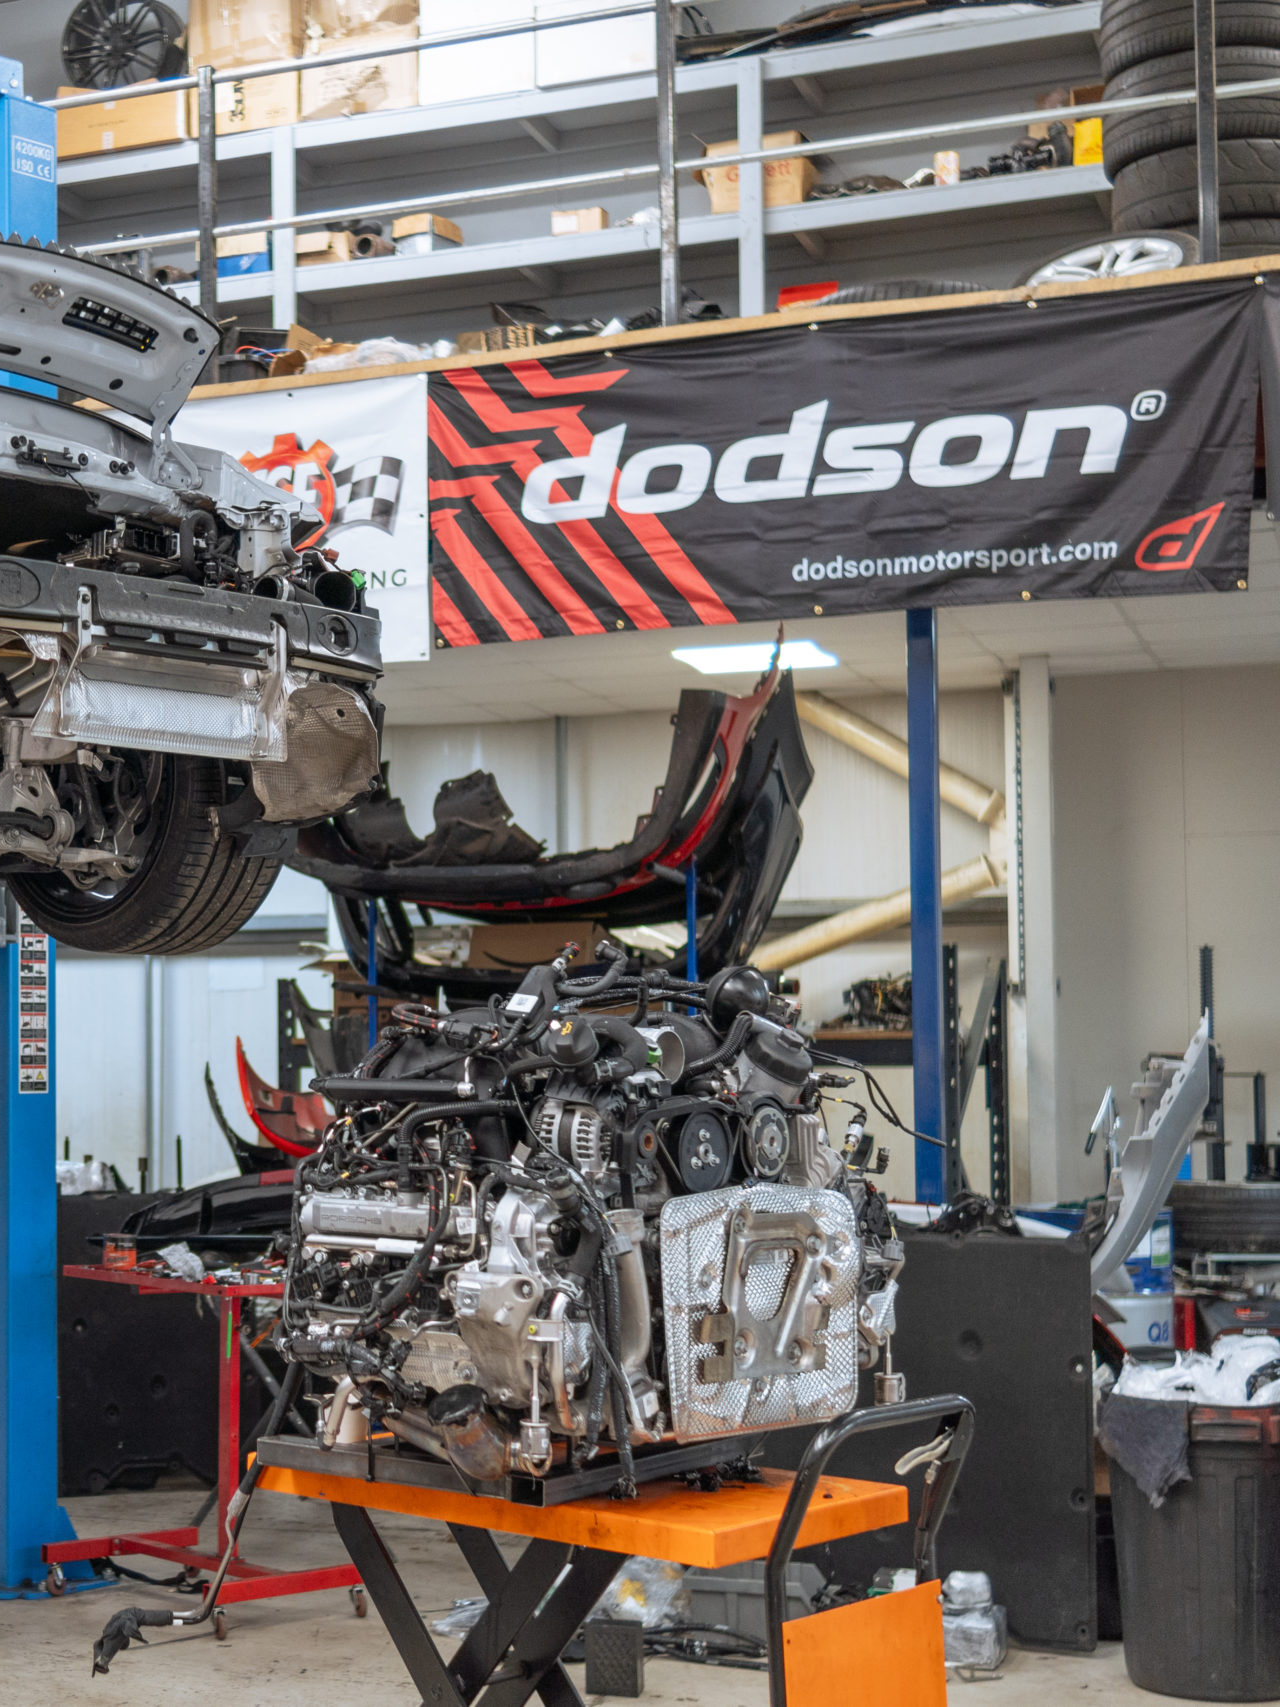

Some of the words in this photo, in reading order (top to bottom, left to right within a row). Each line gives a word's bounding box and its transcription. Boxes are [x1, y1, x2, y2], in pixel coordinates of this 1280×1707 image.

[15, 141, 51, 161] 4200KG
[16, 158, 33, 173] ISO
[791, 540, 1118, 582] dodsonmotorsport.com
[321, 1214, 383, 1226] PORSCHE
[1148, 1321, 1170, 1343] Q8
